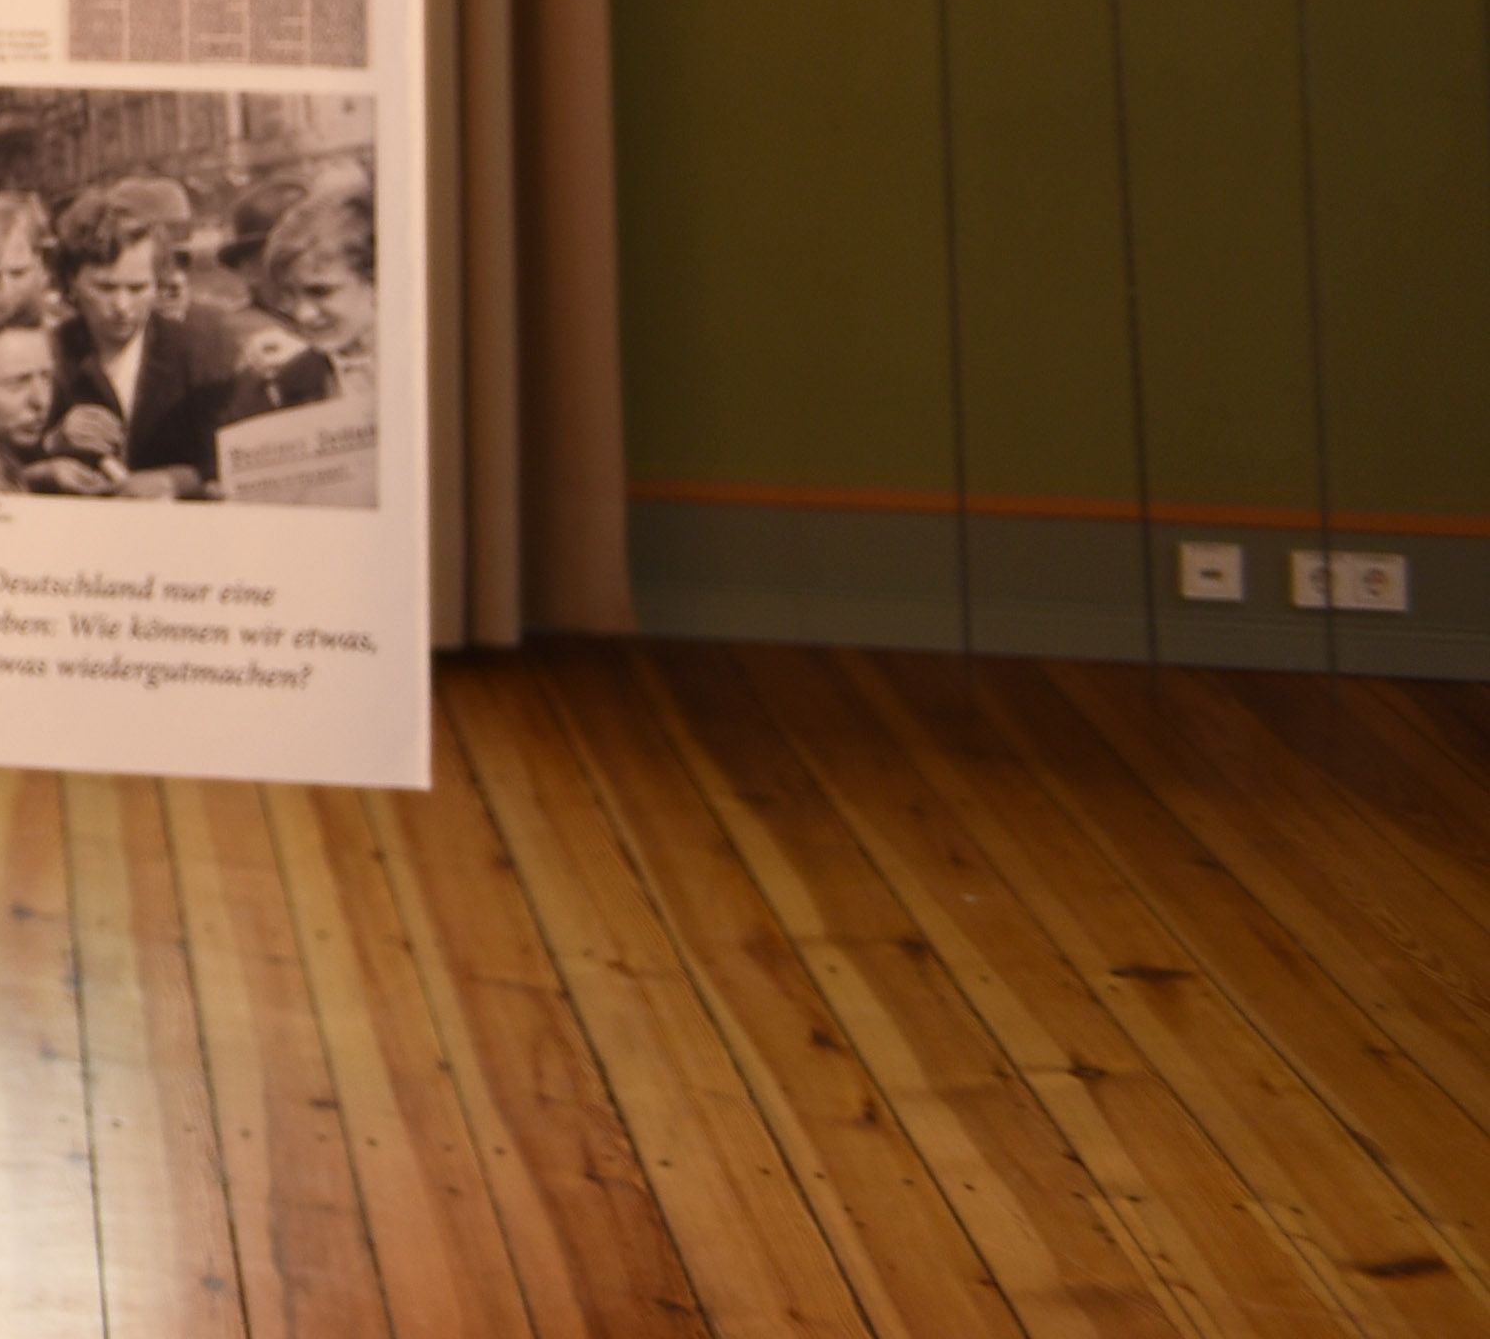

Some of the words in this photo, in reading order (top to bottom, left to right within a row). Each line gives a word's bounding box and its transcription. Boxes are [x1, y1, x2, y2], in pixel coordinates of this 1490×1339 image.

[162, 582, 211, 604] nur
[218, 582, 277, 607] eine
[69, 613, 121, 640] Wie
[130, 616, 231, 645] können
[239, 624, 284, 648] wir
[293, 627, 379, 656] etwas,
[56, 653, 313, 692] wiedergutmachen?
